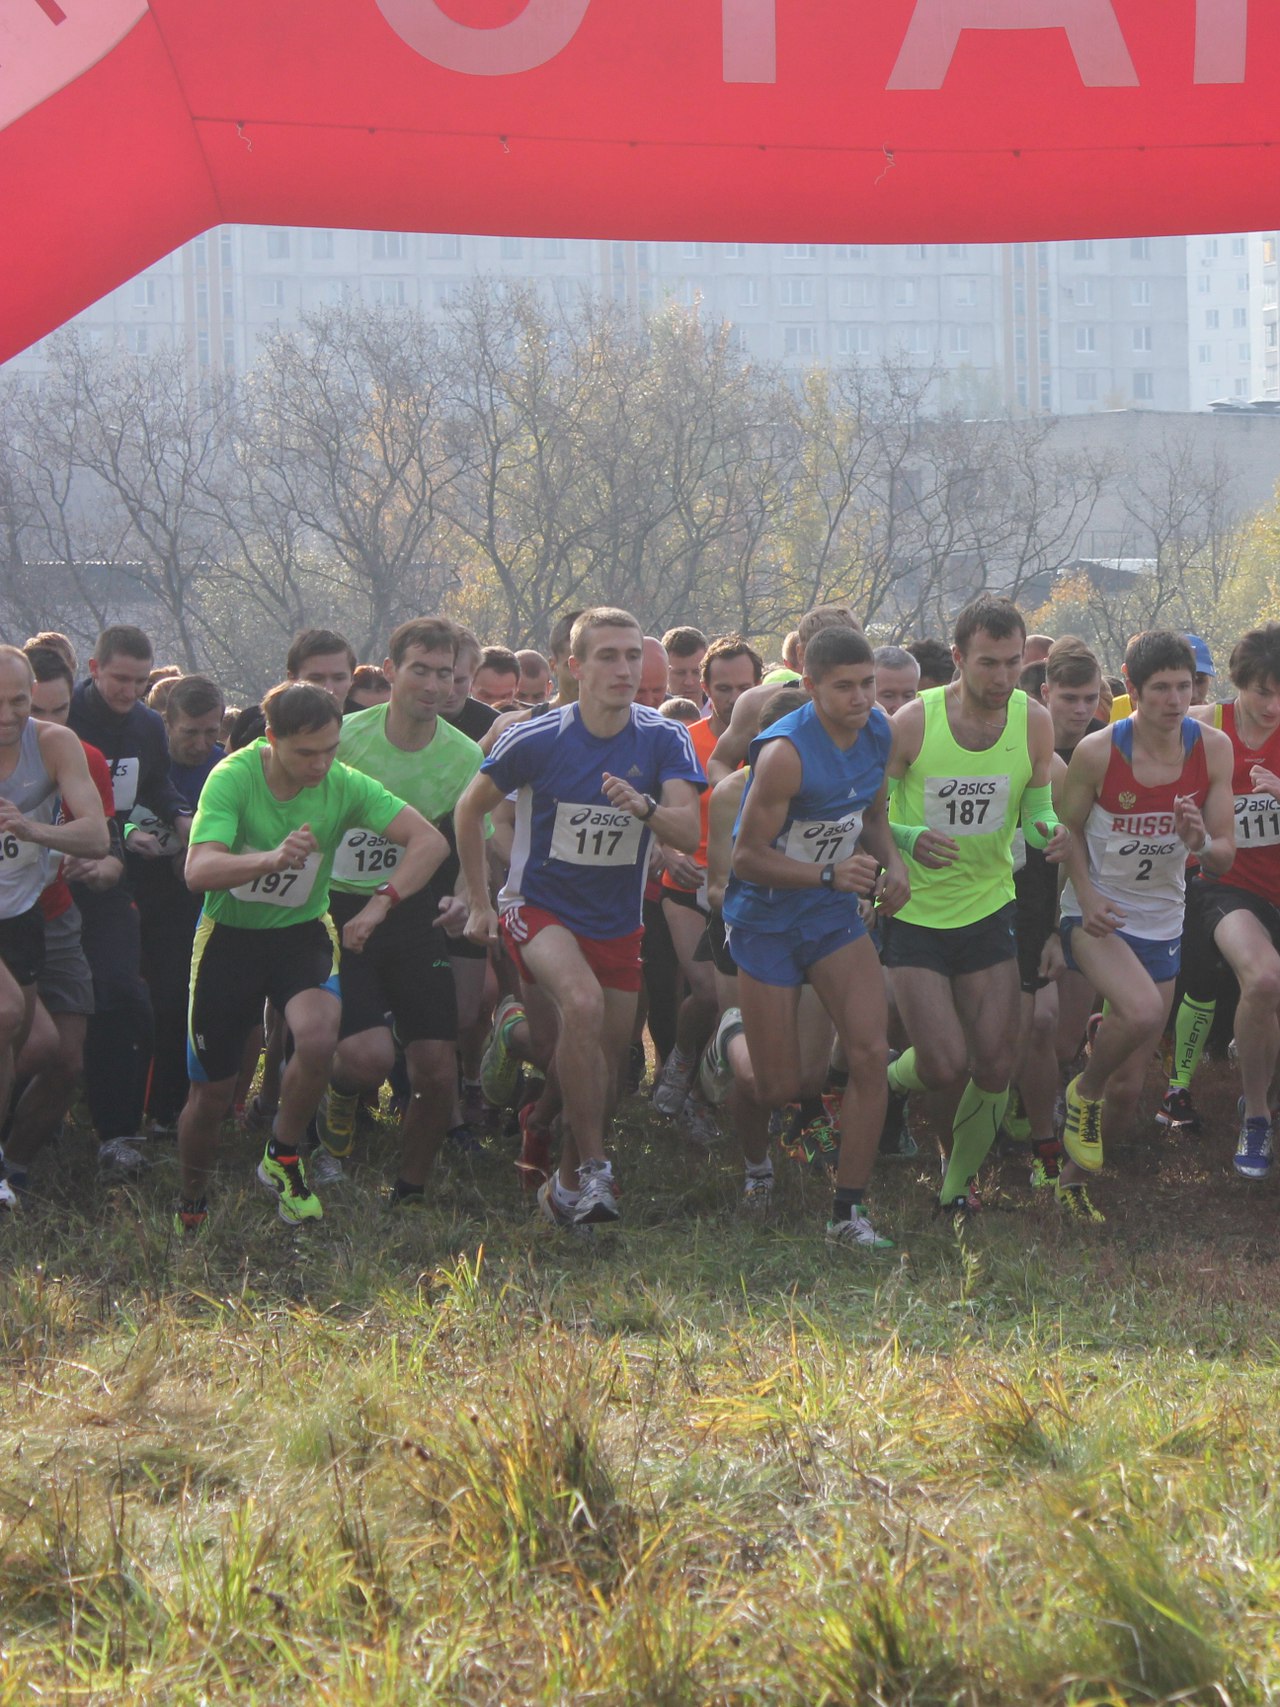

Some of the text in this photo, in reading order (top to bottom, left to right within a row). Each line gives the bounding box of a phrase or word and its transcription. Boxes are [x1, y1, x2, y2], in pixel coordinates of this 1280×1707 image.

[957, 781, 997, 796] asics
[590, 811, 632, 828] asics
[945, 798, 991, 826] 187
[1111, 815, 1177, 837] RUSS
[1239, 812, 1280, 840] 111
[0, 834, 19, 859] 6
[366, 835, 393, 848] asi
[575, 828, 624, 857] 117
[814, 836, 844, 863] 77
[1138, 842, 1176, 856] asics
[354, 847, 398, 873] 126
[1136, 859, 1153, 881] 2
[249, 872, 299, 898] 197
